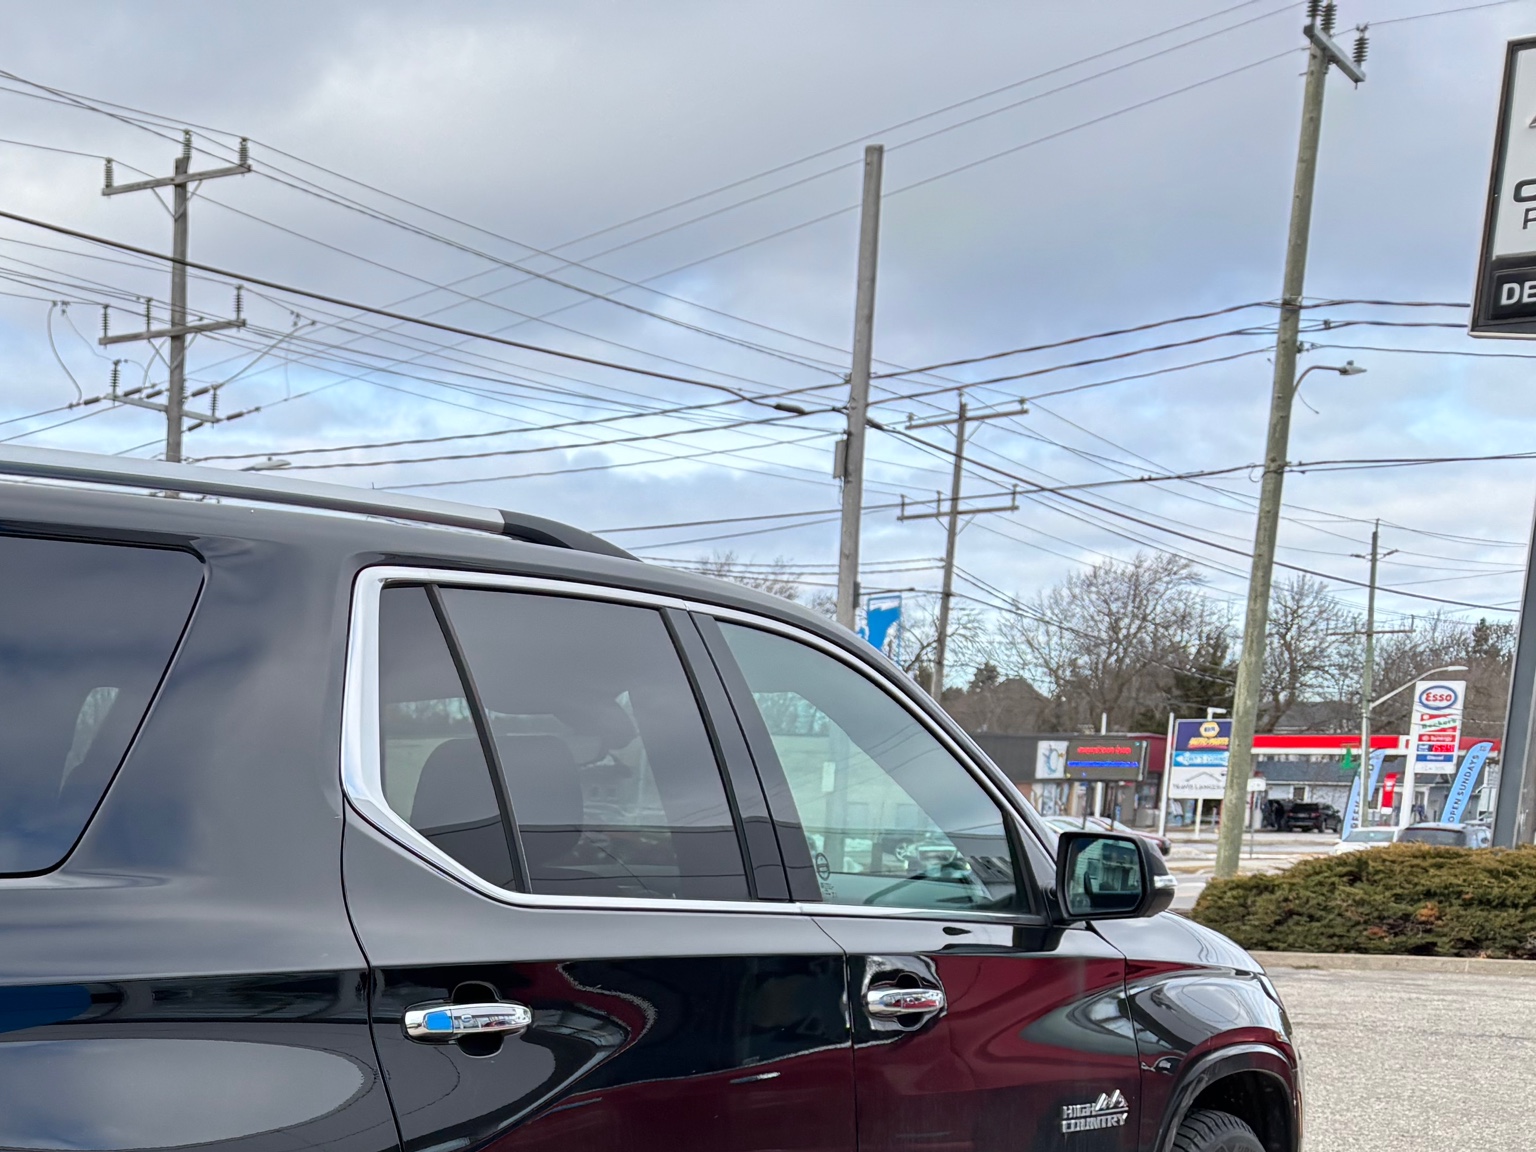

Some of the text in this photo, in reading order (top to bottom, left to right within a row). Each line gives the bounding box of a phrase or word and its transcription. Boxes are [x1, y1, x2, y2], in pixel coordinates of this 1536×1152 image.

[1425, 692, 1452, 702] Esso
[1447, 754, 1480, 822] OPEN SUNDAYS
[1062, 1103, 1096, 1119] HIGH
[1061, 1113, 1128, 1133] COUNTRY
